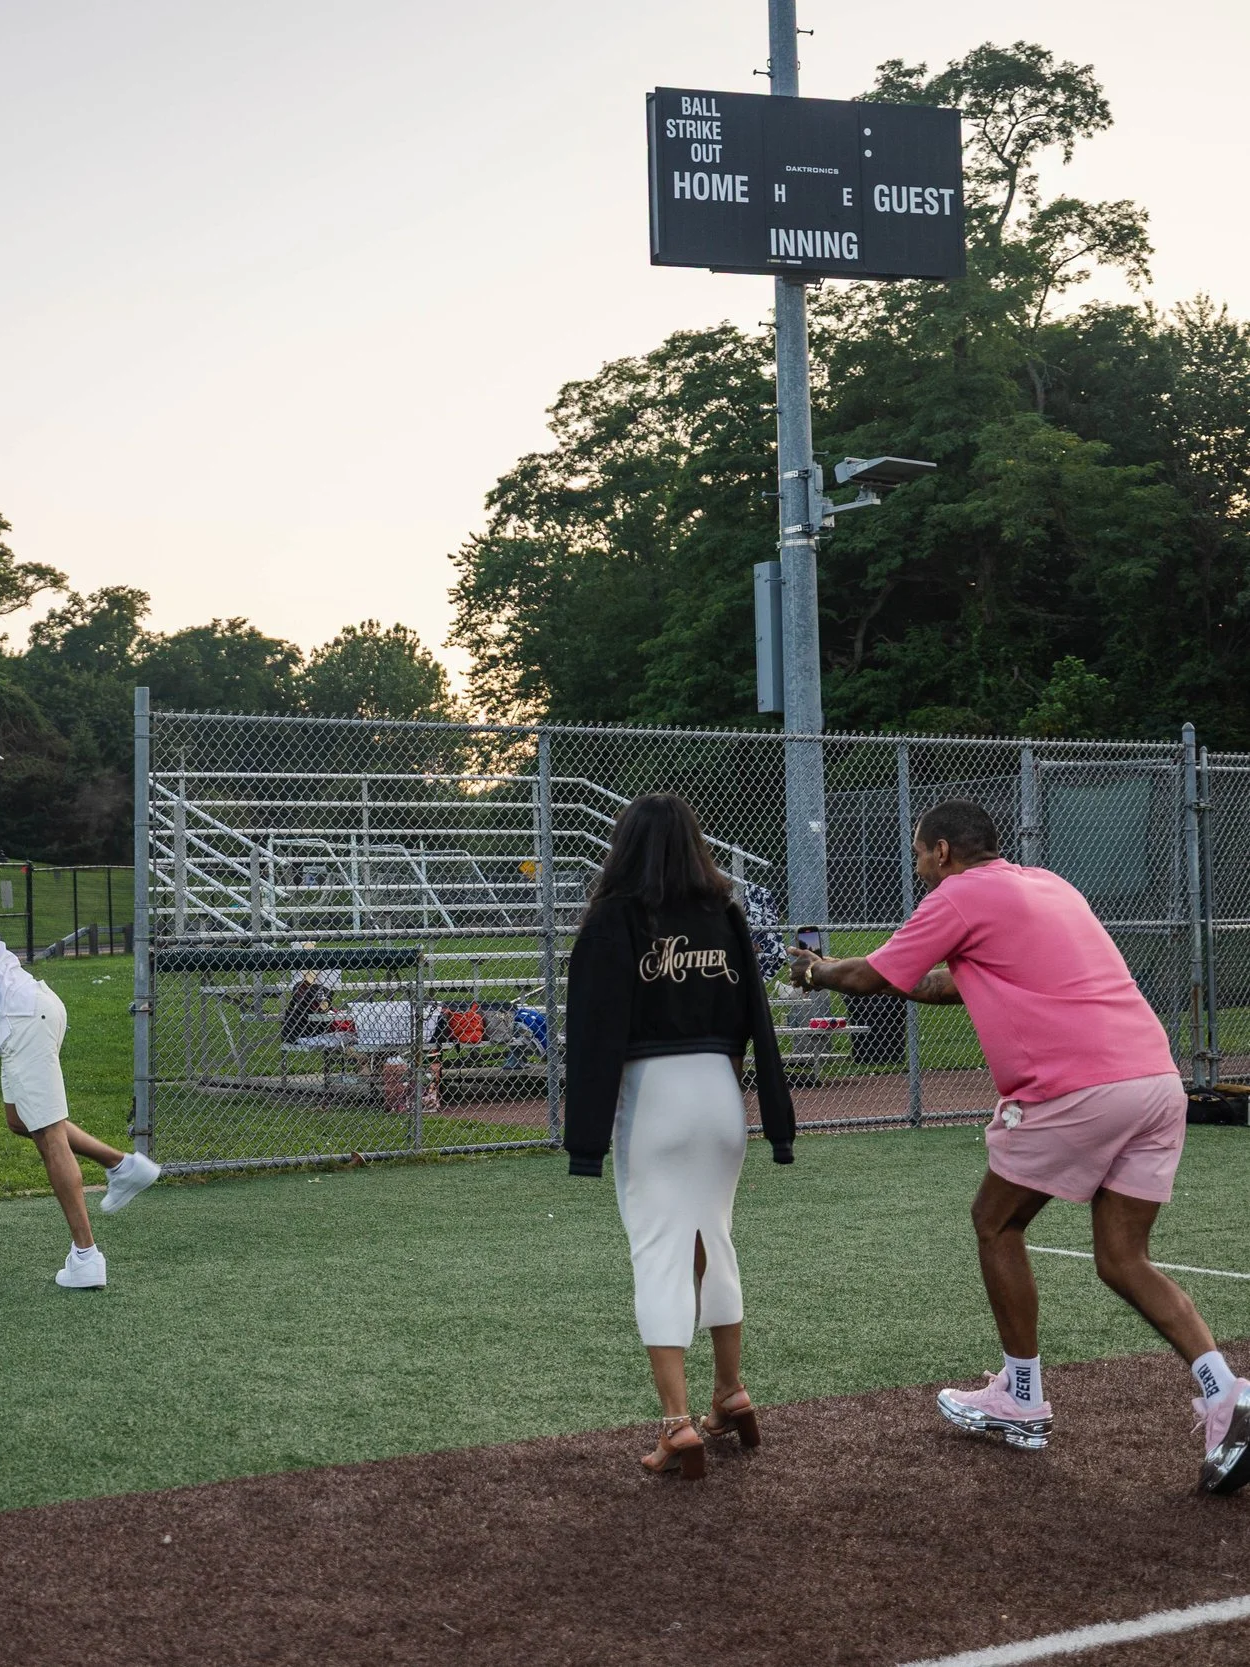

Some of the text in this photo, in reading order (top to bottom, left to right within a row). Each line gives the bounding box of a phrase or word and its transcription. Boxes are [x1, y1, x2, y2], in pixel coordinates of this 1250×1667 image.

[681, 96, 721, 117] BALL
[666, 119, 722, 140] STRIKE
[691, 143, 722, 163] OUT
[786, 165, 839, 175] DAKTRONICS
[673, 171, 955, 216] HOME H E GUEST
[770, 228, 858, 260] INNING
[1015, 1366, 1031, 1401] BERRI
[1197, 1363, 1220, 1399] BERRI
